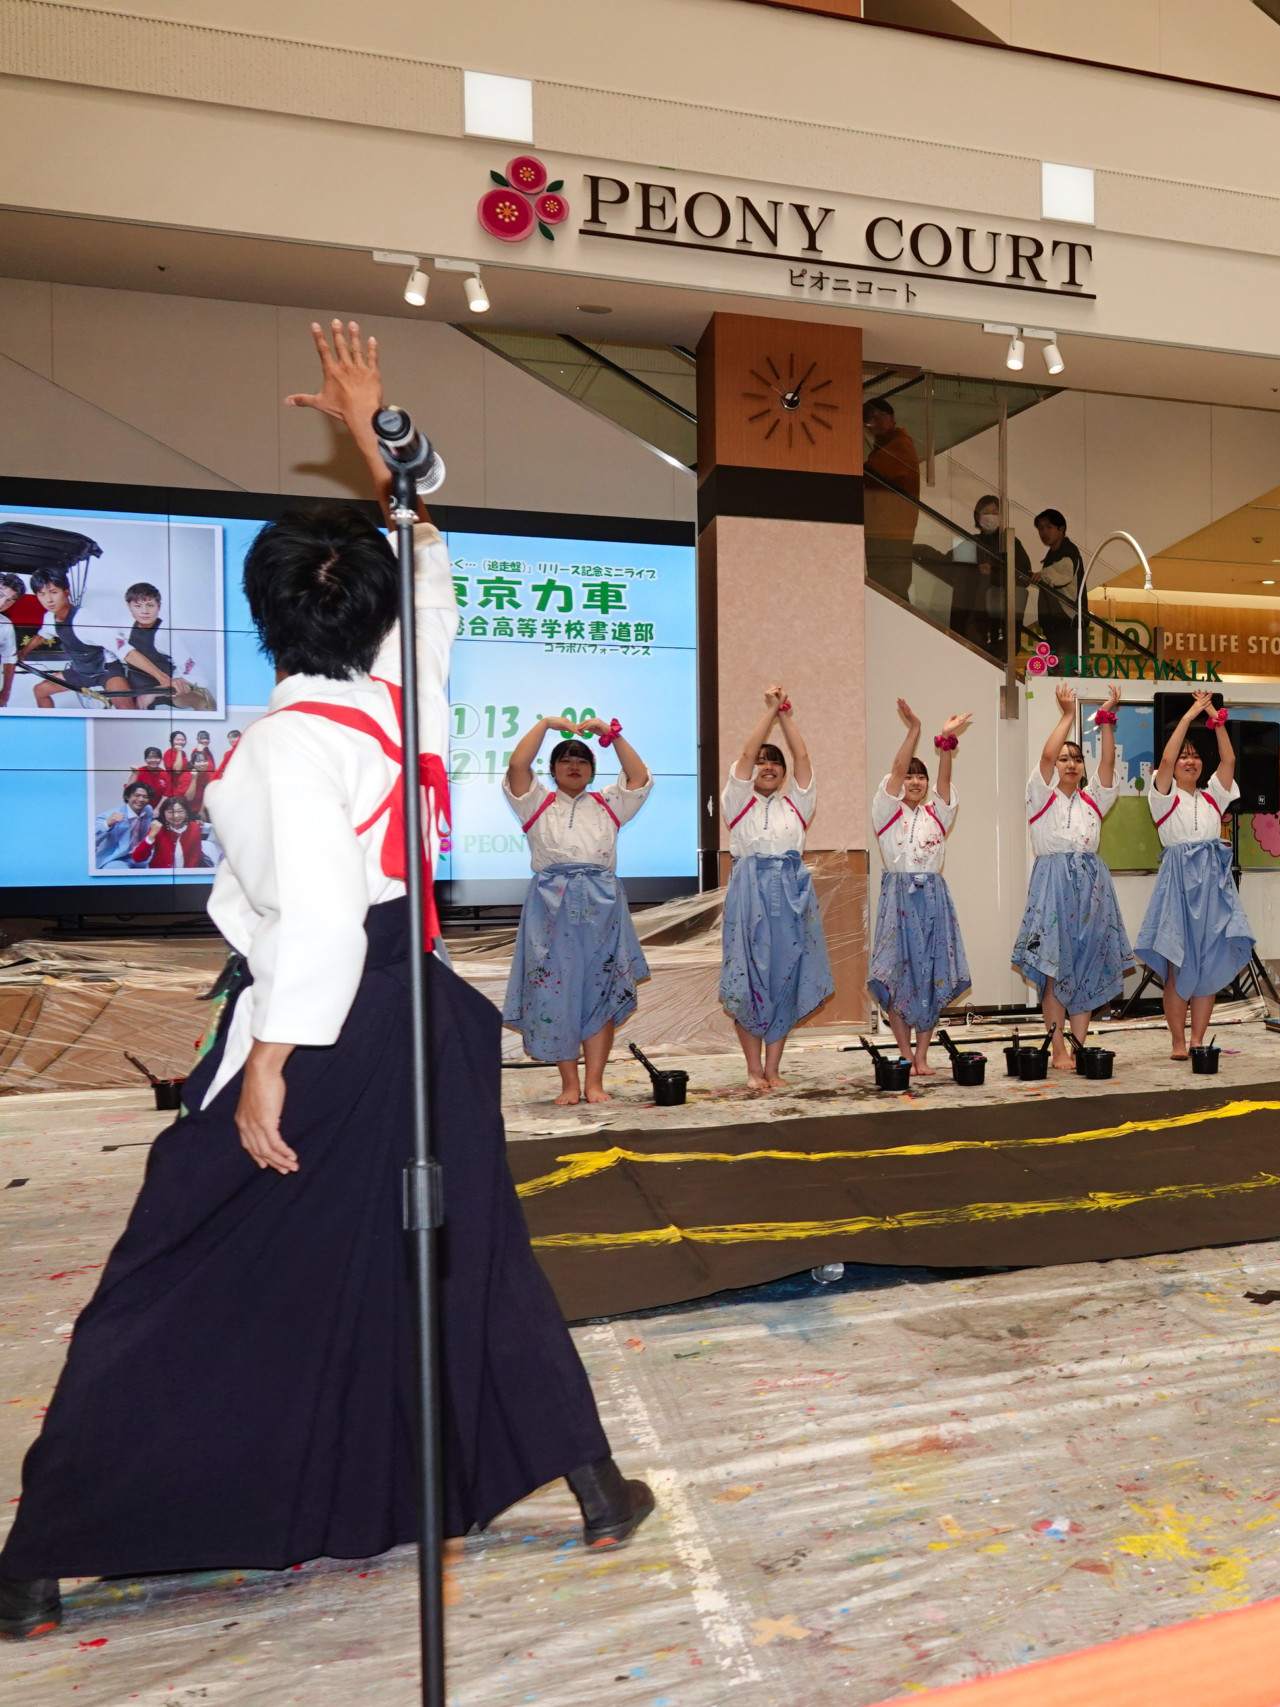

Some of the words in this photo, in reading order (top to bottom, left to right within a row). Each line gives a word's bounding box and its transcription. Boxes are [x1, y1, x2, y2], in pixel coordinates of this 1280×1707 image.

[583, 174, 836, 253] PEONY
[865, 216, 1093, 287] COURT
[788, 268, 917, 303] ピオニコート
[544, 642, 652, 657] コラボパフォーマンス
[1163, 631, 1239, 653] PETLIFE
[463, 833, 527, 854] PEON
